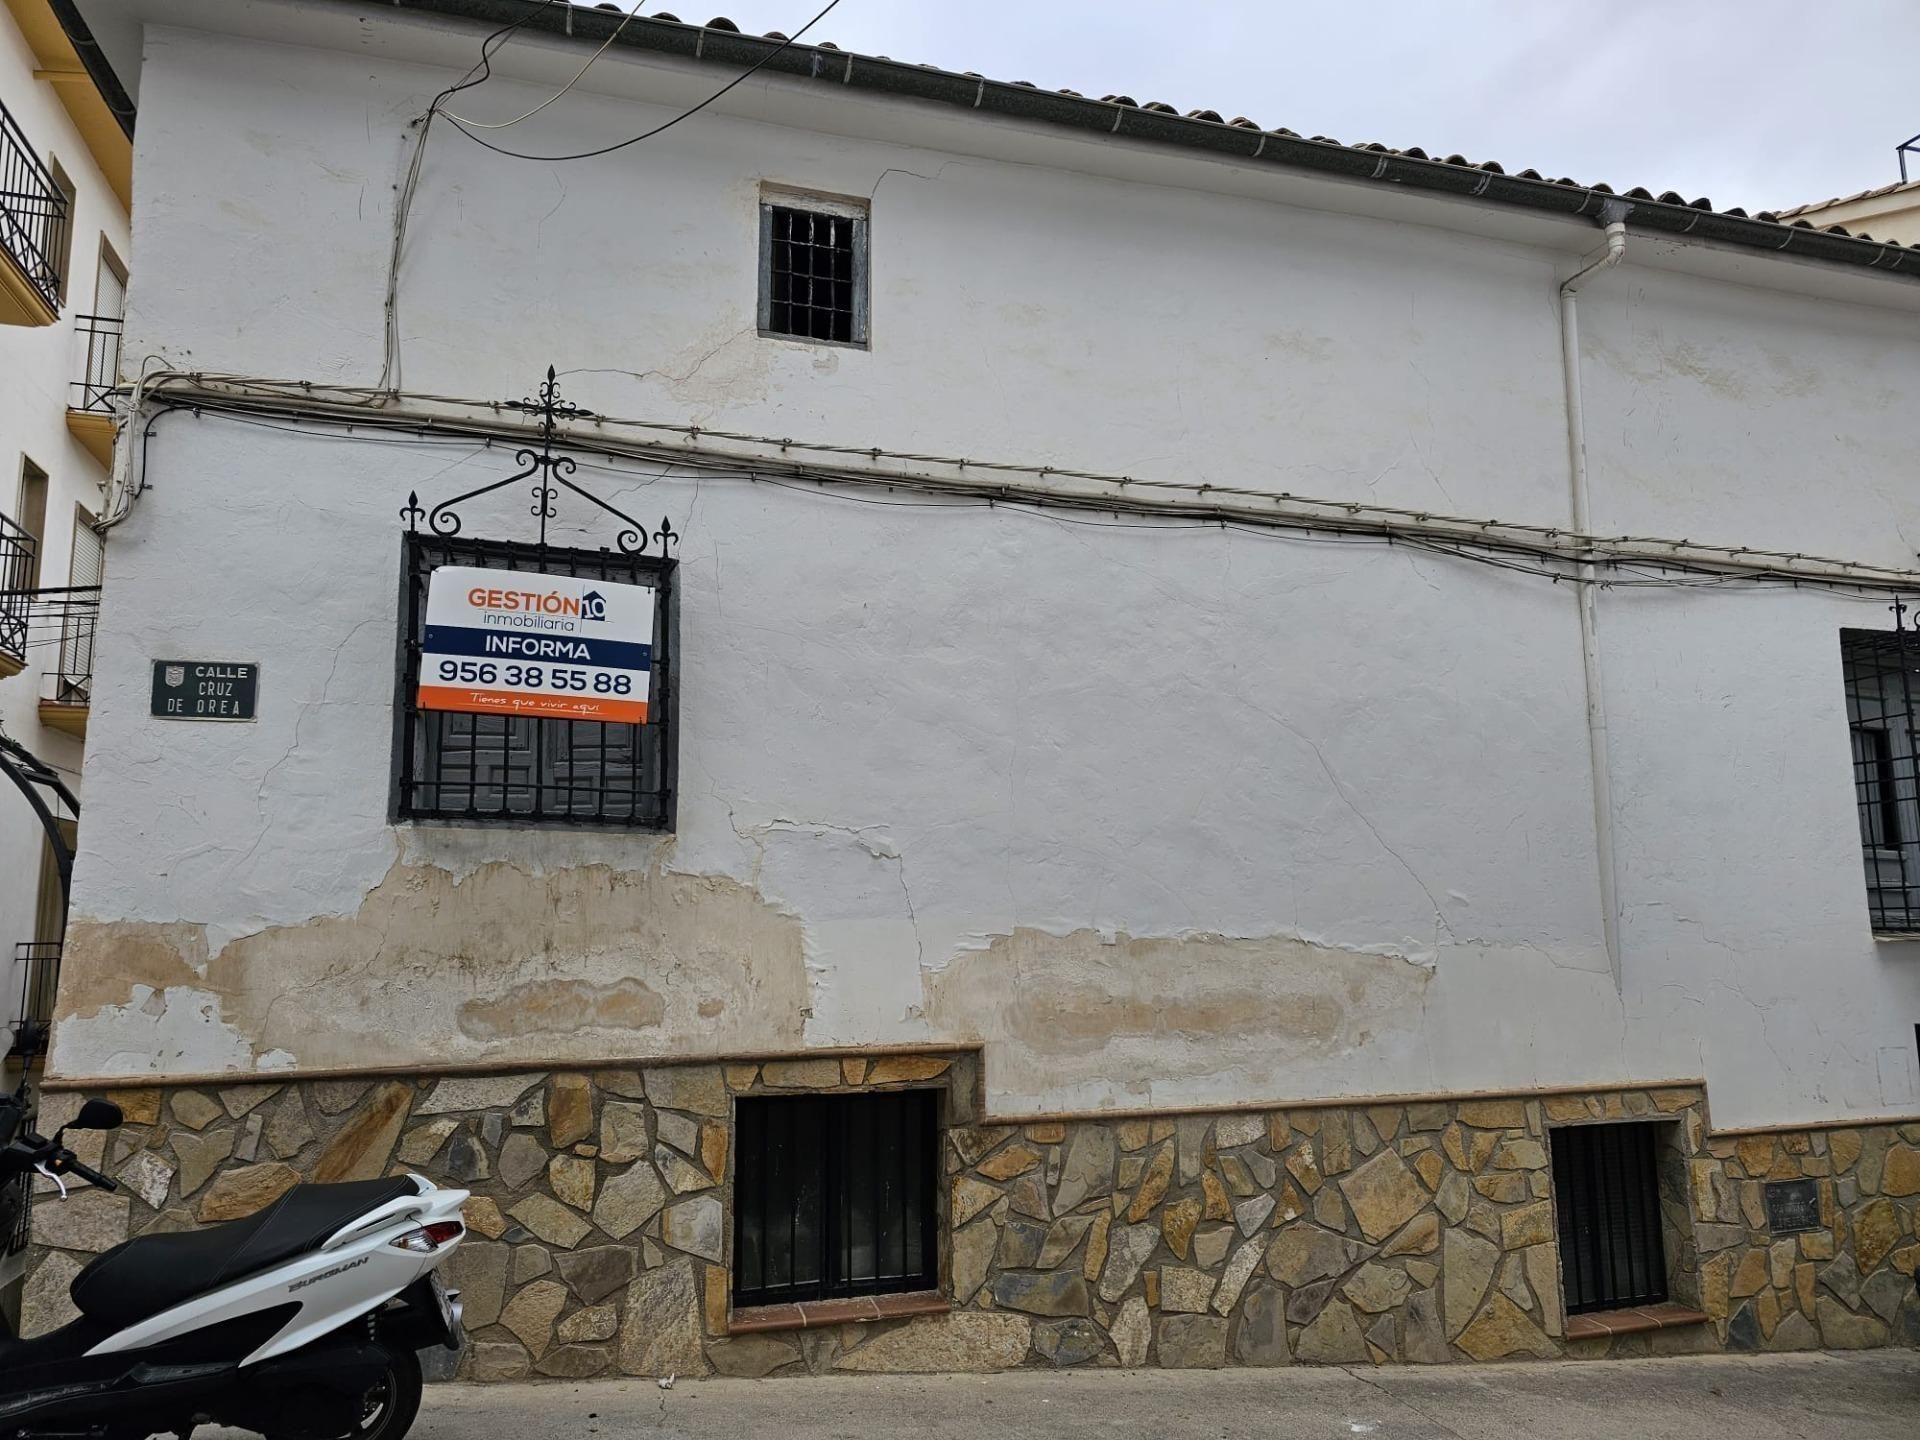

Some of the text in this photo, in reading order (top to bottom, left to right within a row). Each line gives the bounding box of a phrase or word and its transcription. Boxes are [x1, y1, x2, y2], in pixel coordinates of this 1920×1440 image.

[468, 588, 580, 615] GESTIÓN
[483, 611, 575, 632] inmobiliaria
[485, 635, 591, 660] INFORMA
[195, 666, 248, 679] CALLE
[439, 660, 632, 695] 956 38 55 88
[199, 681, 233, 696] CRUZ
[167, 698, 240, 715] DE OREA
[470, 692, 507, 705] Tienes
[513, 698, 535, 712] que
[540, 701, 567, 710] vivir
